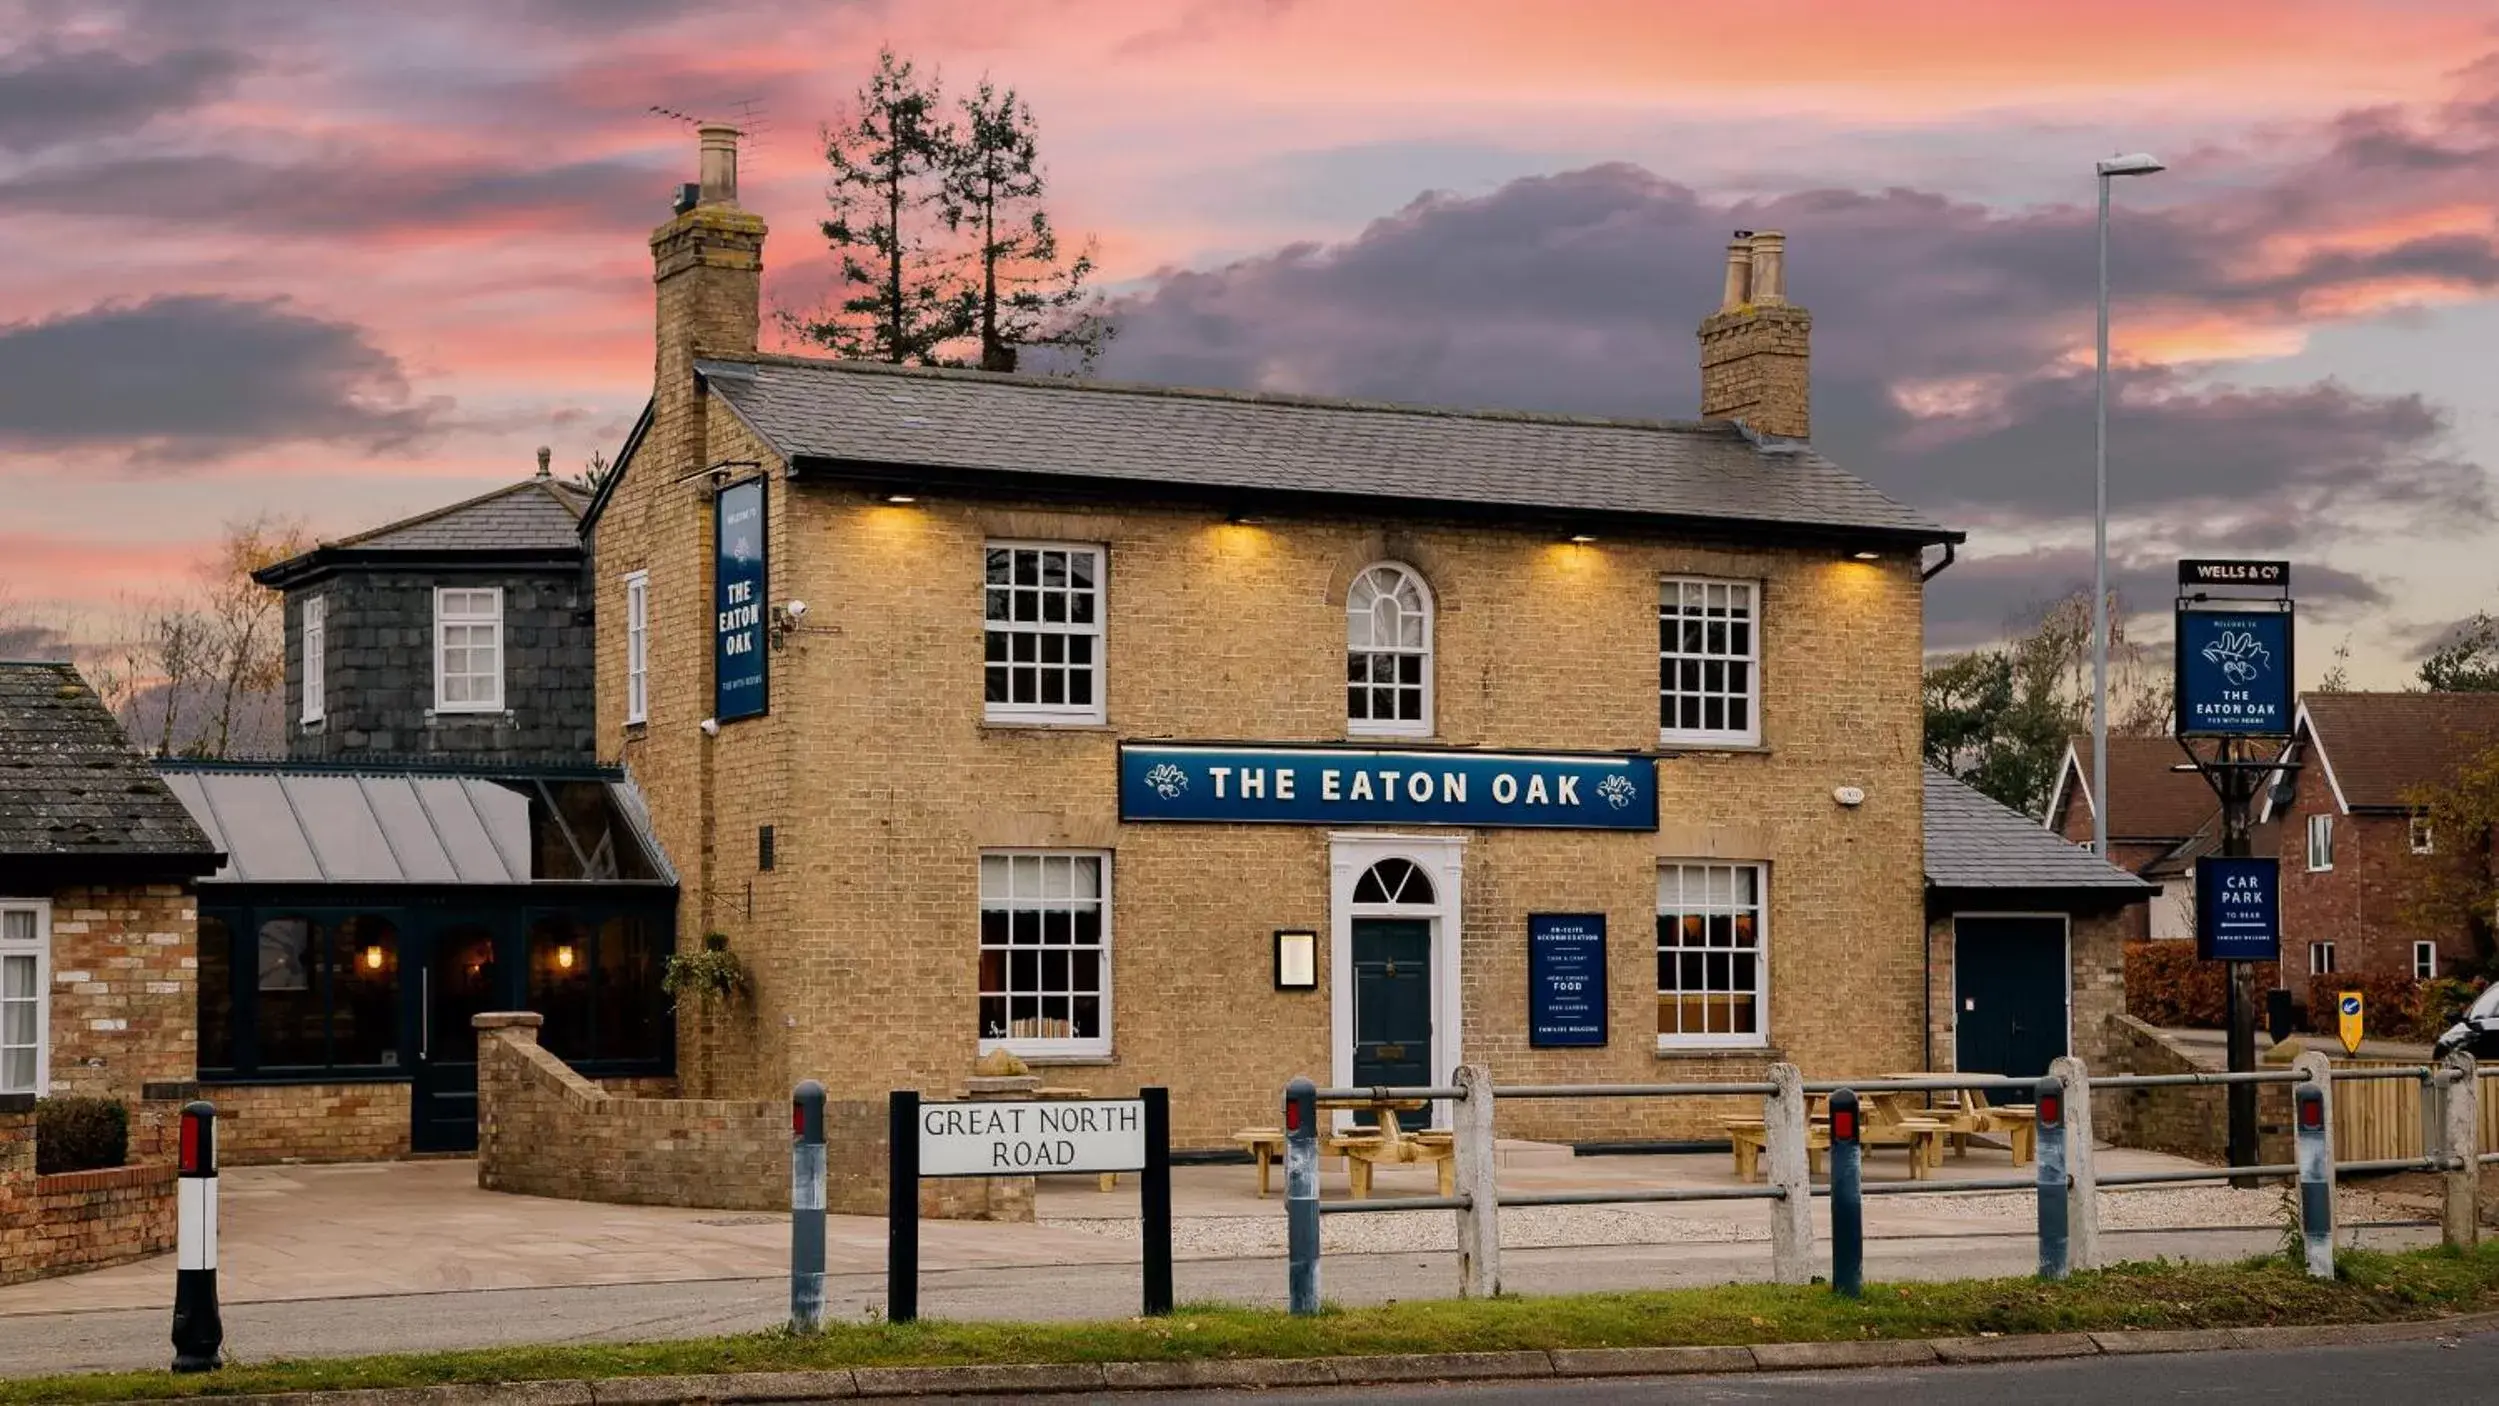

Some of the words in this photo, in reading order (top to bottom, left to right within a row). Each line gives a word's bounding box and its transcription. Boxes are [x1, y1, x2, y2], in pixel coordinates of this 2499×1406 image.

[2197, 565, 2246, 579] WELLS
[2249, 566, 2258, 579] &
[728, 580, 752, 605] THE
[719, 603, 760, 633] EATON
[726, 631, 752, 656] OAK
[2223, 690, 2249, 701] THE
[2196, 703, 2242, 715] EATON
[2246, 703, 2275, 715] OAK
[1209, 767, 1295, 800] THE
[1321, 769, 1467, 803] EATON
[1491, 774, 1581, 806] OAK
[2226, 876, 2259, 889] CAR
[2221, 892, 2263, 904] PARK
[2225, 911, 2237, 919] TO
[2239, 911, 2261, 919] REAR
[1553, 982, 1582, 991] FOOD
[924, 1109, 1025, 1136] GREAT
[1039, 1107, 1137, 1133] NORTH
[992, 1140, 1075, 1167] ROAD
